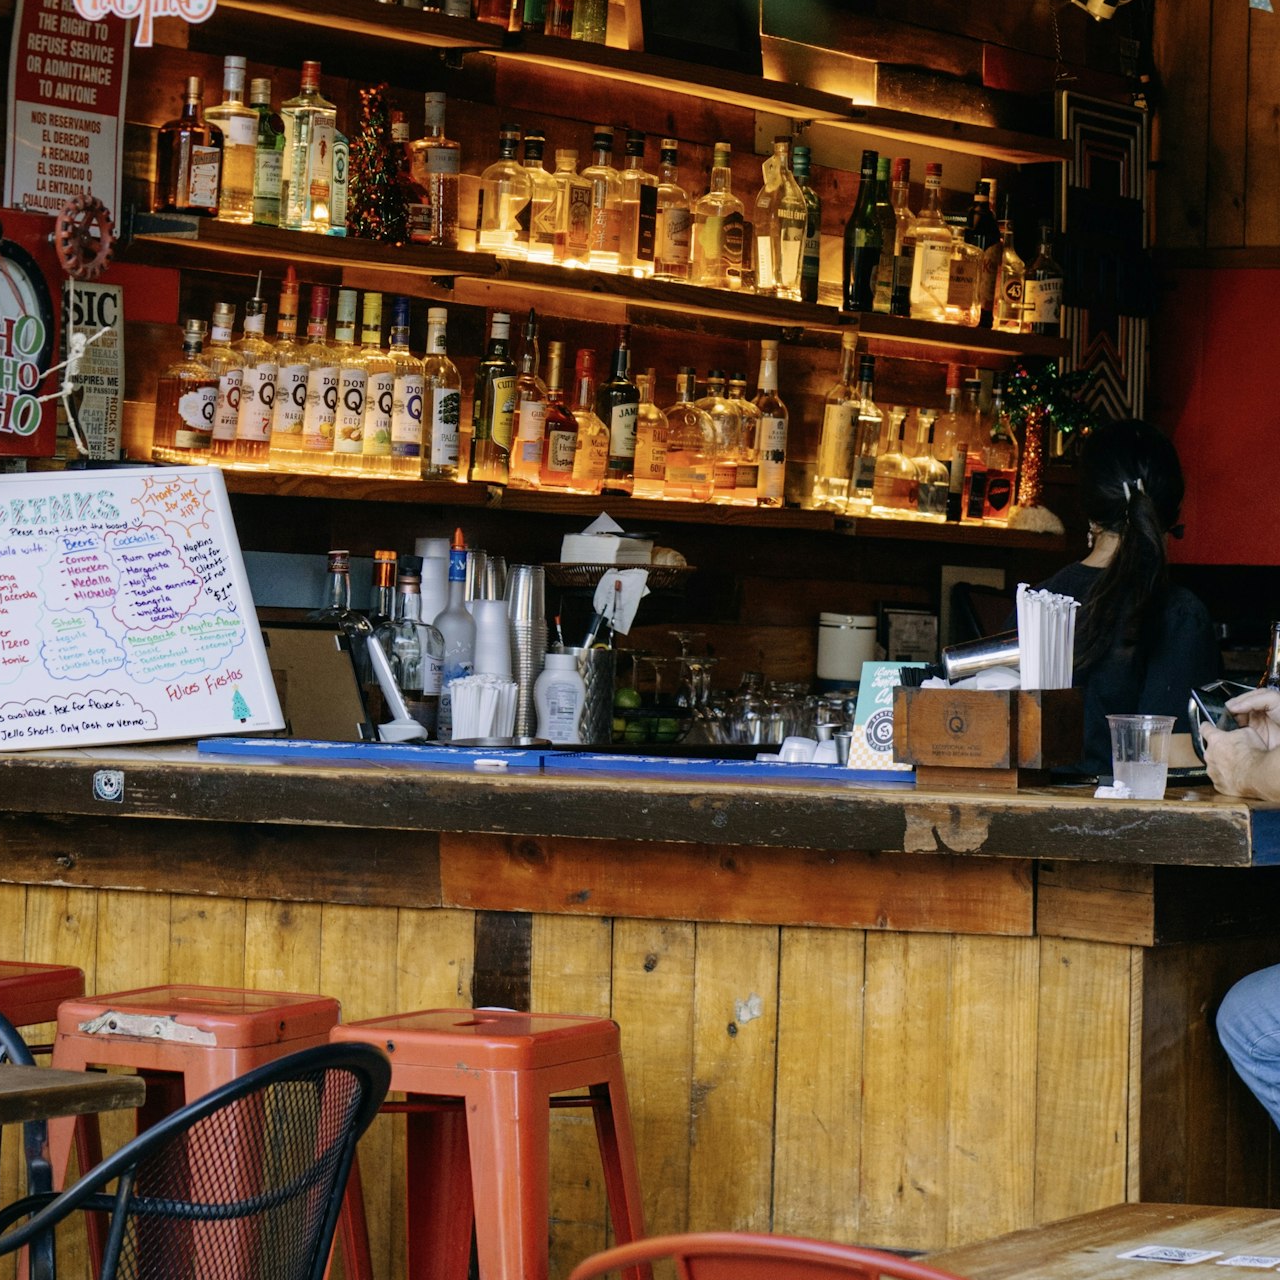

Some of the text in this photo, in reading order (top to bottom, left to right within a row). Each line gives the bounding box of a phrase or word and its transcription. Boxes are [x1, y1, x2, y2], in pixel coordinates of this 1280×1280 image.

[38, 12, 109, 41] THE RIGHT TO
[27, 33, 115, 65] REFUSE SERVICE
[26, 55, 112, 86] OR ADMITTANCE
[39, 79, 97, 106] TO ANYONE
[31, 110, 102, 134] NOS RESERVAMOS
[42, 129, 90, 150] EL DERECHO
[48, 147, 90, 166] RECHAZAR
[37, 161, 86, 182] EL SERVICIO
[36, 178, 86, 198] LA ENTRADA
[572, 188, 591, 203] FEW
[1008, 281, 1022, 298] 43
[92, 348, 118, 359] HEALS
[107, 377, 119, 387] ME
[258, 382, 275, 410] Q
[343, 388, 364, 416] Q
[109, 397, 119, 433] ROCKS
[202, 401, 215, 424] Q
[406, 395, 423, 424] Q
[85, 423, 104, 435] THE
[261, 417, 270, 435] 7
[144, 483, 181, 505] Thanks
[164, 489, 195, 513] for the
[10, 520, 128, 538] Please don't touch the board
[183, 538, 214, 552] Napkins
[66, 554, 99, 564] Corona
[122, 548, 173, 564] Rum punch
[189, 547, 221, 564] only for
[67, 563, 109, 577] Heineken
[126, 562, 171, 577] Margarita
[214, 567, 227, 579] not
[71, 575, 112, 587] Medalla
[74, 586, 118, 601] Michelob
[131, 586, 163, 598] Tequila
[166, 668, 244, 702] Felices Fiestas
[54, 704, 70, 715] Ask
[72, 701, 86, 711] for
[0, 729, 25, 742] Jello
[60, 722, 80, 735] Only
[82, 720, 103, 730] Cash
